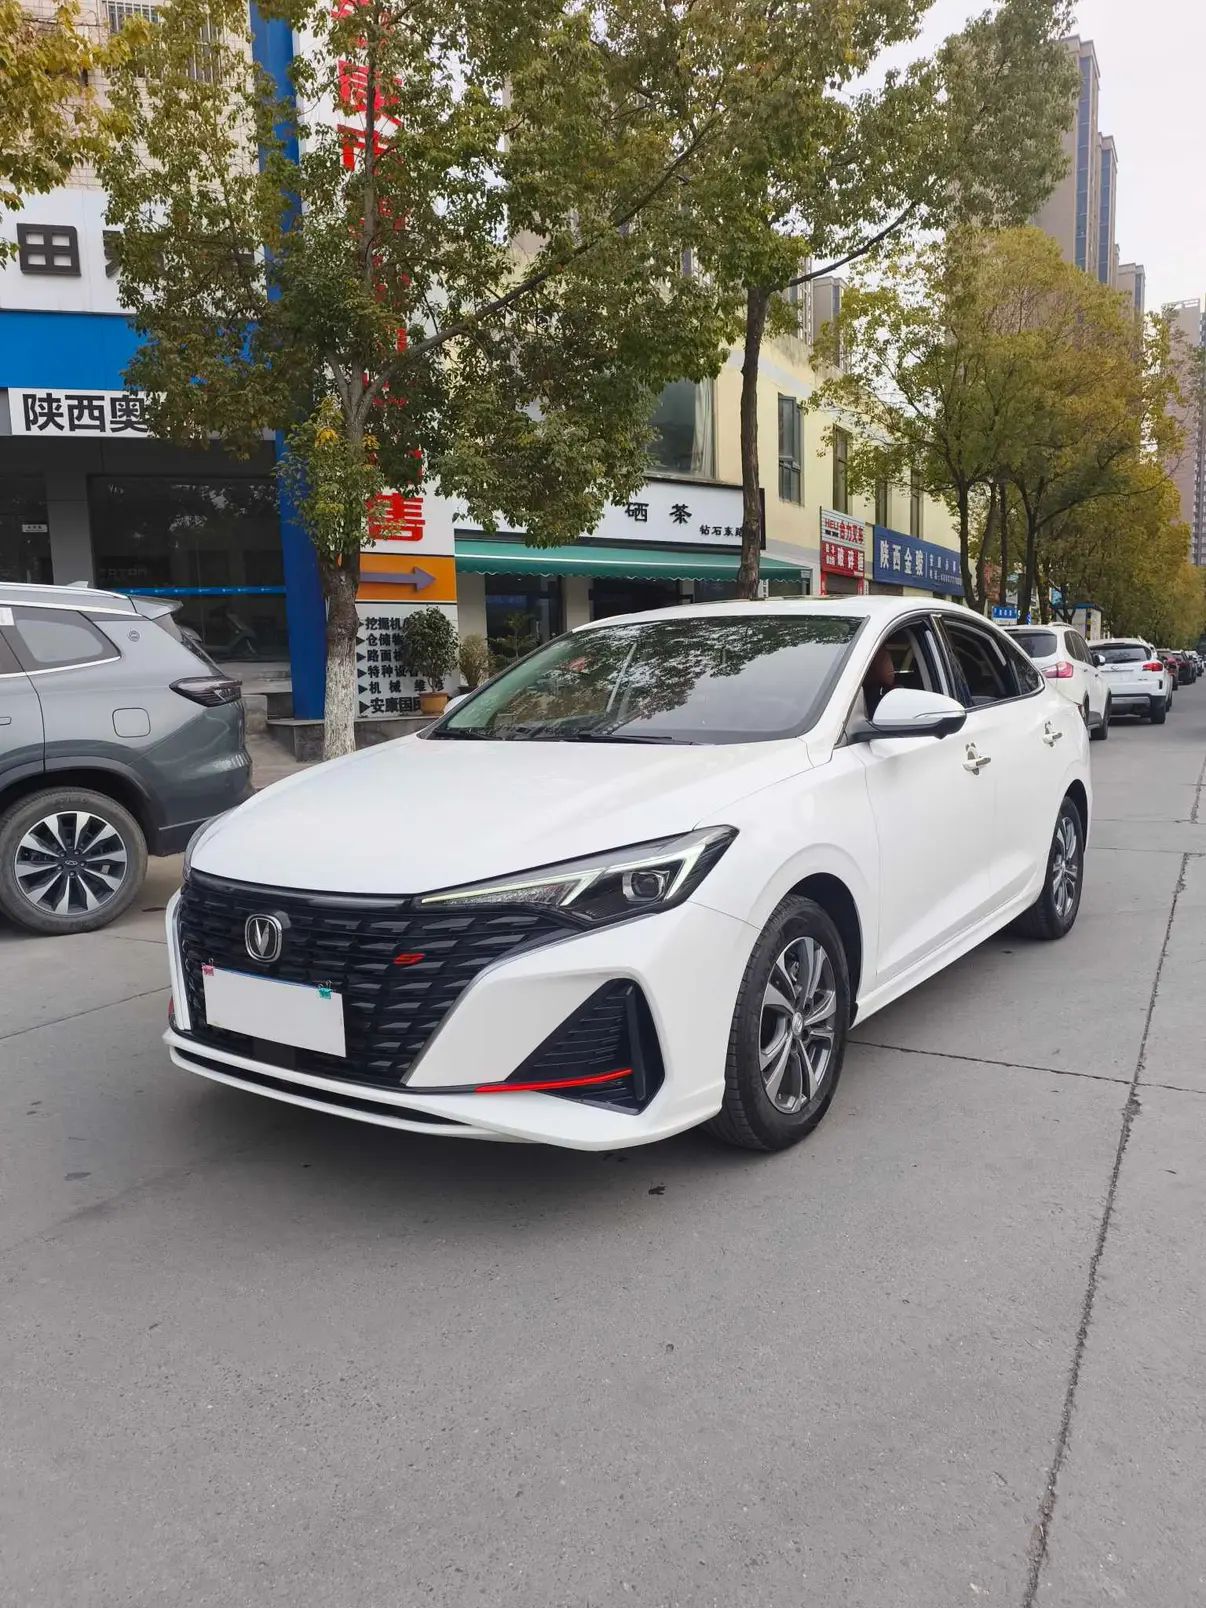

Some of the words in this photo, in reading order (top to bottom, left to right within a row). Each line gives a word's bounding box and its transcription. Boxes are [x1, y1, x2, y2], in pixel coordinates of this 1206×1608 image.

[17, 223, 81, 277] 田
[22, 392, 149, 433] 陕西奥
